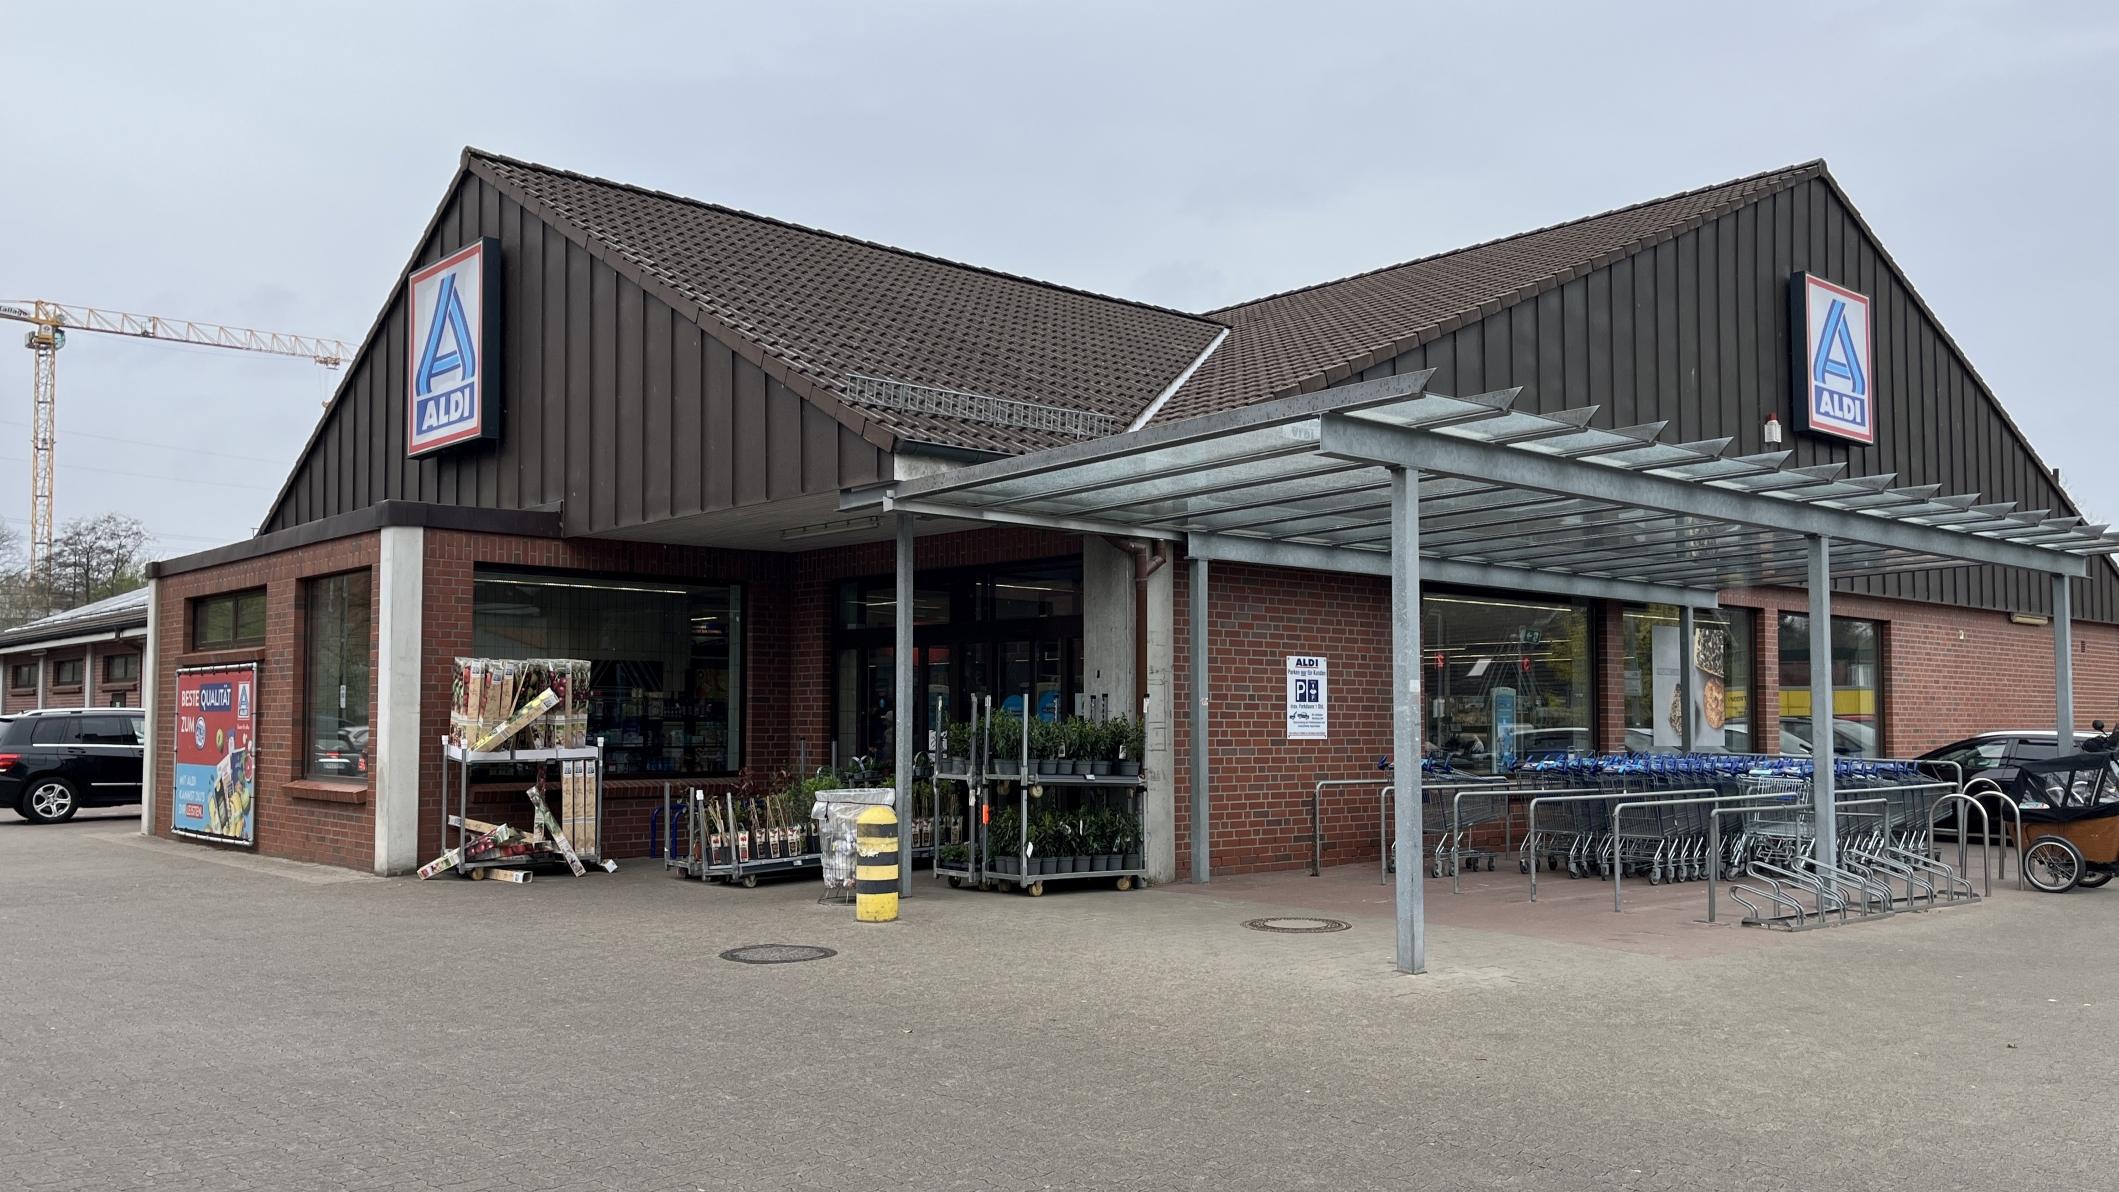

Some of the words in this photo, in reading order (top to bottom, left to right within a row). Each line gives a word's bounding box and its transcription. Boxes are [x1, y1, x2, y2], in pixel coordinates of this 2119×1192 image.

[421, 387, 470, 430] ALDI
[1819, 390, 1862, 424] ALDI
[1296, 658, 1318, 667] ALDI
[181, 690, 200, 707] BESTE
[201, 684, 231, 711] QUALITÄT
[1296, 681, 1306, 701] P
[181, 716, 195, 733] ZUM
